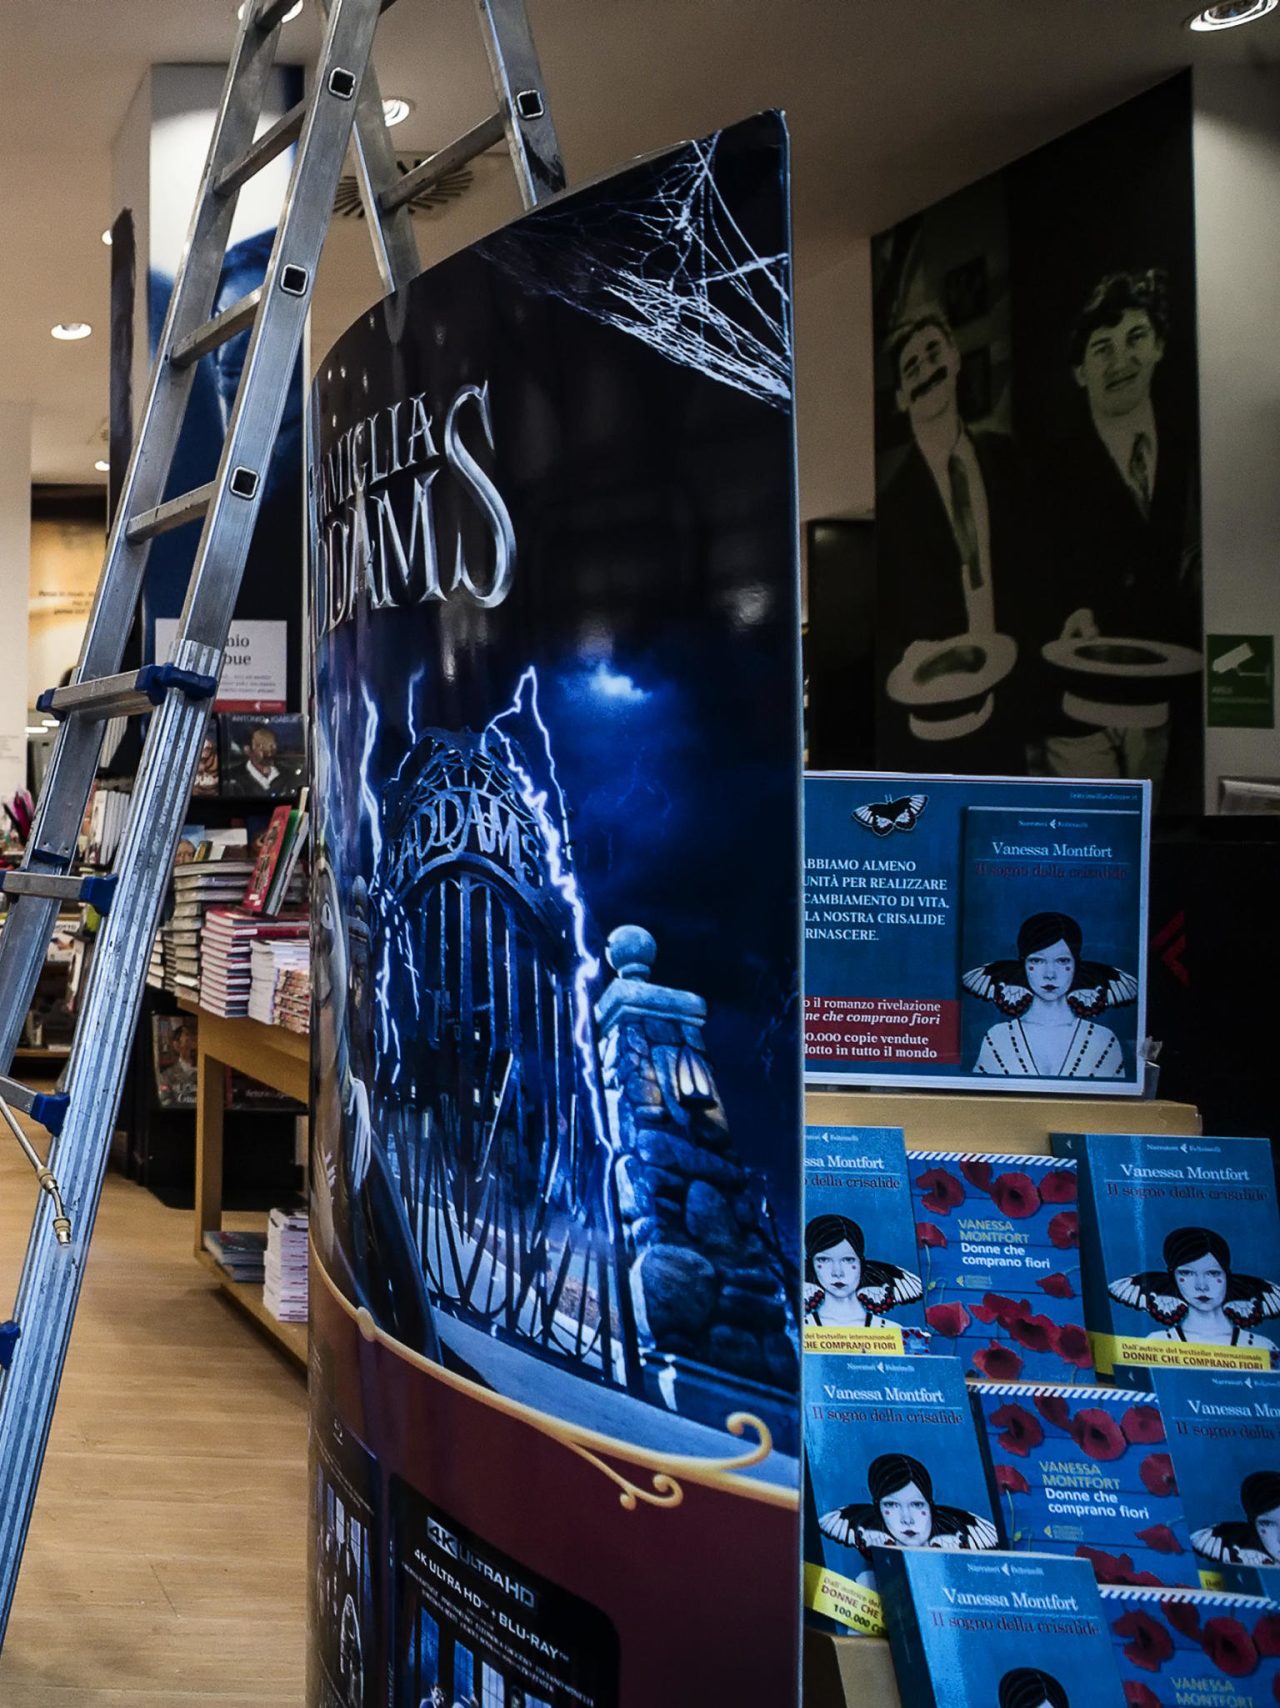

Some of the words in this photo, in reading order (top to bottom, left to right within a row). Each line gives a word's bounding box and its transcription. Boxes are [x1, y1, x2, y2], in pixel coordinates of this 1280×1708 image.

[992, 841, 1049, 856] Vanessa
[1053, 843, 1113, 858] Montfort
[862, 859, 917, 872] ALMENO
[842, 876, 867, 888] PER
[870, 877, 948, 891] REALIZZARE
[804, 893, 897, 906] CAMBIAMENTO
[900, 895, 915, 907] DI
[805, 910, 821, 922] LA
[823, 911, 874, 923] NOSTRA
[877, 913, 946, 926] CRISALIDE
[805, 928, 879, 941] RINASCERE.
[813, 997, 821, 1008] il
[824, 999, 875, 1010] romanzo
[877, 999, 941, 1012] rivelazione
[805, 1011, 821, 1021] ne
[822, 1010, 844, 1021] che
[846, 1013, 909, 1025] comprano
[908, 1012, 941, 1027] fiori
[844, 1032, 878, 1046] copie
[880, 1033, 929, 1045] vendute
[836, 1044, 849, 1056] in
[851, 1046, 881, 1057] tutto
[883, 1046, 892, 1058] il
[895, 1046, 938, 1059] mondo
[827, 1155, 885, 1170] Montfort
[1120, 1163, 1185, 1179] Vanessa
[1186, 1165, 1250, 1181] Montfort
[811, 1173, 842, 1187] della
[846, 1175, 900, 1189] crisalide
[1170, 1185, 1205, 1199] della
[957, 1218, 1015, 1231] VANESSA
[959, 1230, 1030, 1244] MONTFORT
[961, 1242, 1001, 1254] Donne
[1003, 1244, 1025, 1256] che
[962, 1256, 1022, 1268] comprano
[1024, 1256, 1050, 1269] fiori
[820, 1340, 871, 1351] COMPRANO
[873, 1341, 896, 1351] FIORI
[1122, 1351, 1158, 1362] DONNE
[1161, 1354, 1180, 1364] CHE
[1183, 1356, 1236, 1368] COMPRANO
[1239, 1361, 1263, 1370] FIORI
[823, 1384, 883, 1400] Vanessa
[884, 1386, 945, 1403] Montfort
[812, 1406, 823, 1419] Il
[827, 1409, 867, 1423] sogno
[870, 1408, 903, 1423] della
[906, 1410, 963, 1425] crisalide
[1187, 1399, 1252, 1417] Vanessa
[1176, 1421, 1188, 1435] Il
[1193, 1424, 1237, 1439] sogno
[1038, 1460, 1102, 1475] VANESSA
[1042, 1474, 1120, 1490] MONTFORT
[1045, 1487, 1090, 1501] Donne
[1094, 1490, 1118, 1504] che
[1048, 1503, 1117, 1517] comprano
[1119, 1504, 1150, 1519] fiori
[414, 1549, 428, 1566] 4K
[428, 1560, 463, 1595] ULTRA
[458, 1543, 504, 1590] ULTRA
[504, 1575, 535, 1608] HD
[821, 1584, 858, 1608] DONNE
[861, 1604, 879, 1619] CHE
[942, 1587, 1009, 1607] Vanessa
[1010, 1591, 1079, 1611] Montfort
[931, 1612, 945, 1627] Il
[949, 1616, 994, 1631] sogno
[996, 1615, 1033, 1633] della
[1036, 1618, 1099, 1637] crisalide
[1170, 1676, 1235, 1692] VANESSA
